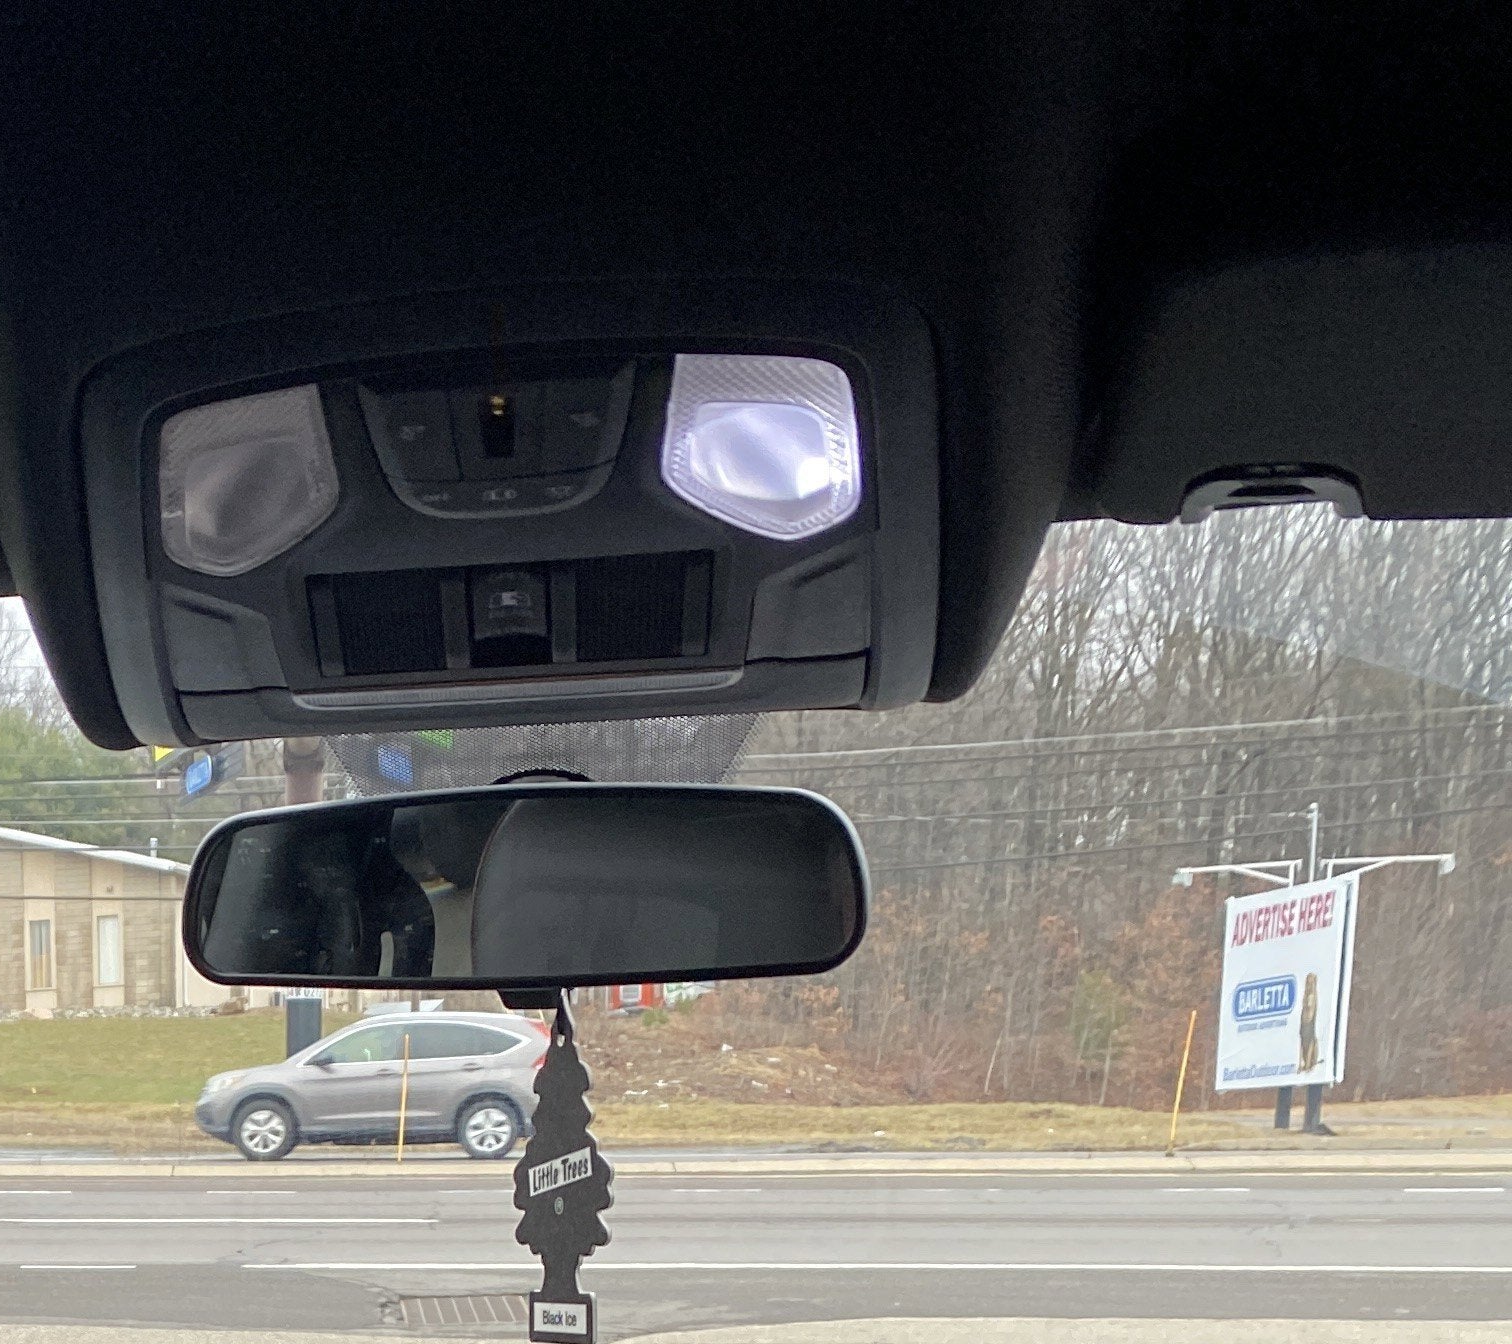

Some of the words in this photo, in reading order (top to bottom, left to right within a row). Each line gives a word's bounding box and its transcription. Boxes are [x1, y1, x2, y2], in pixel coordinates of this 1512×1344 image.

[1231, 901, 1297, 948] ADVERTISE
[1298, 890, 1337, 934] HERE!
[1238, 983, 1290, 1016] BARLETTA
[532, 1163, 559, 1194] Little
[561, 1157, 589, 1186] Trees
[542, 1310, 564, 1326] Black
[565, 1313, 577, 1327] Ice
